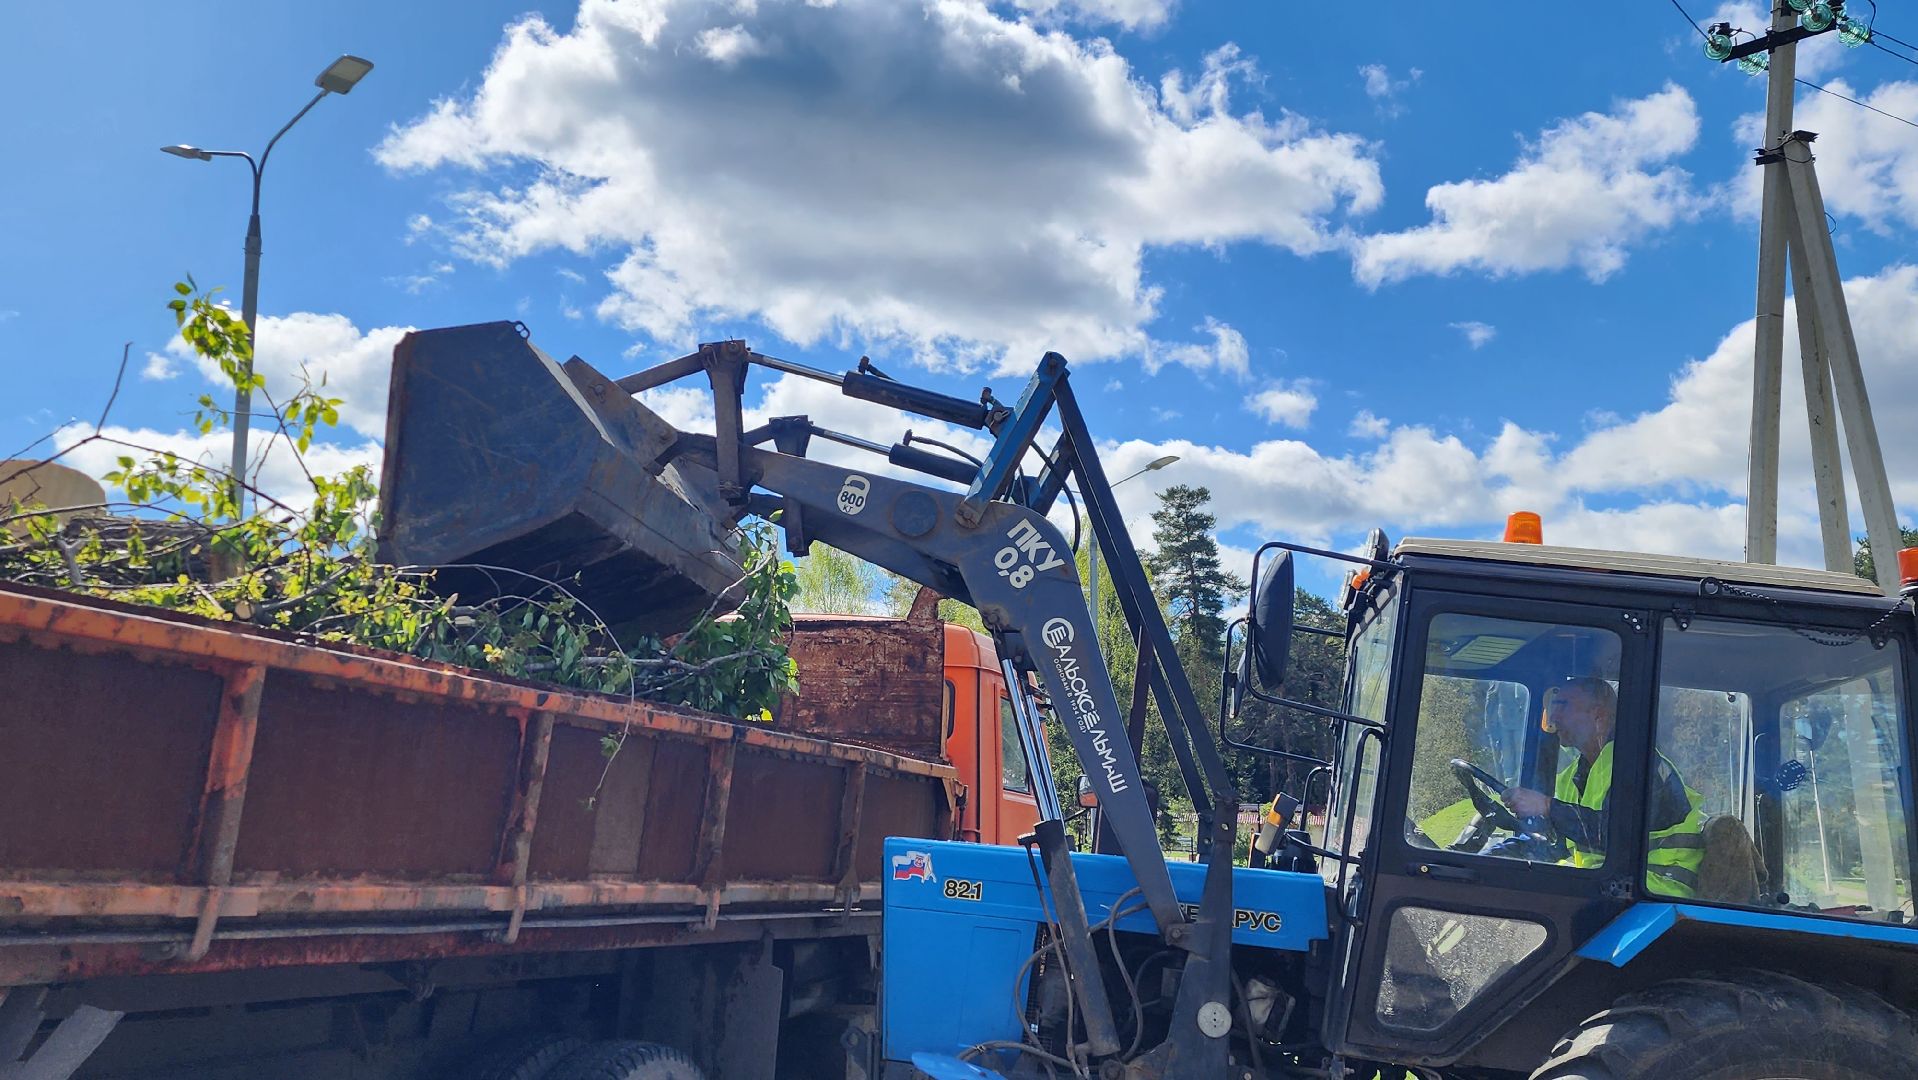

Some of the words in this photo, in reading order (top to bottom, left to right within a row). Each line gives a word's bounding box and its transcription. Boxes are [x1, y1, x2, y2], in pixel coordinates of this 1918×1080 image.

[840, 491, 864, 507] 800
[1006, 518, 1065, 572] ПКУ
[994, 546, 1034, 589] 0,8
[944, 879, 982, 901] 82.1
